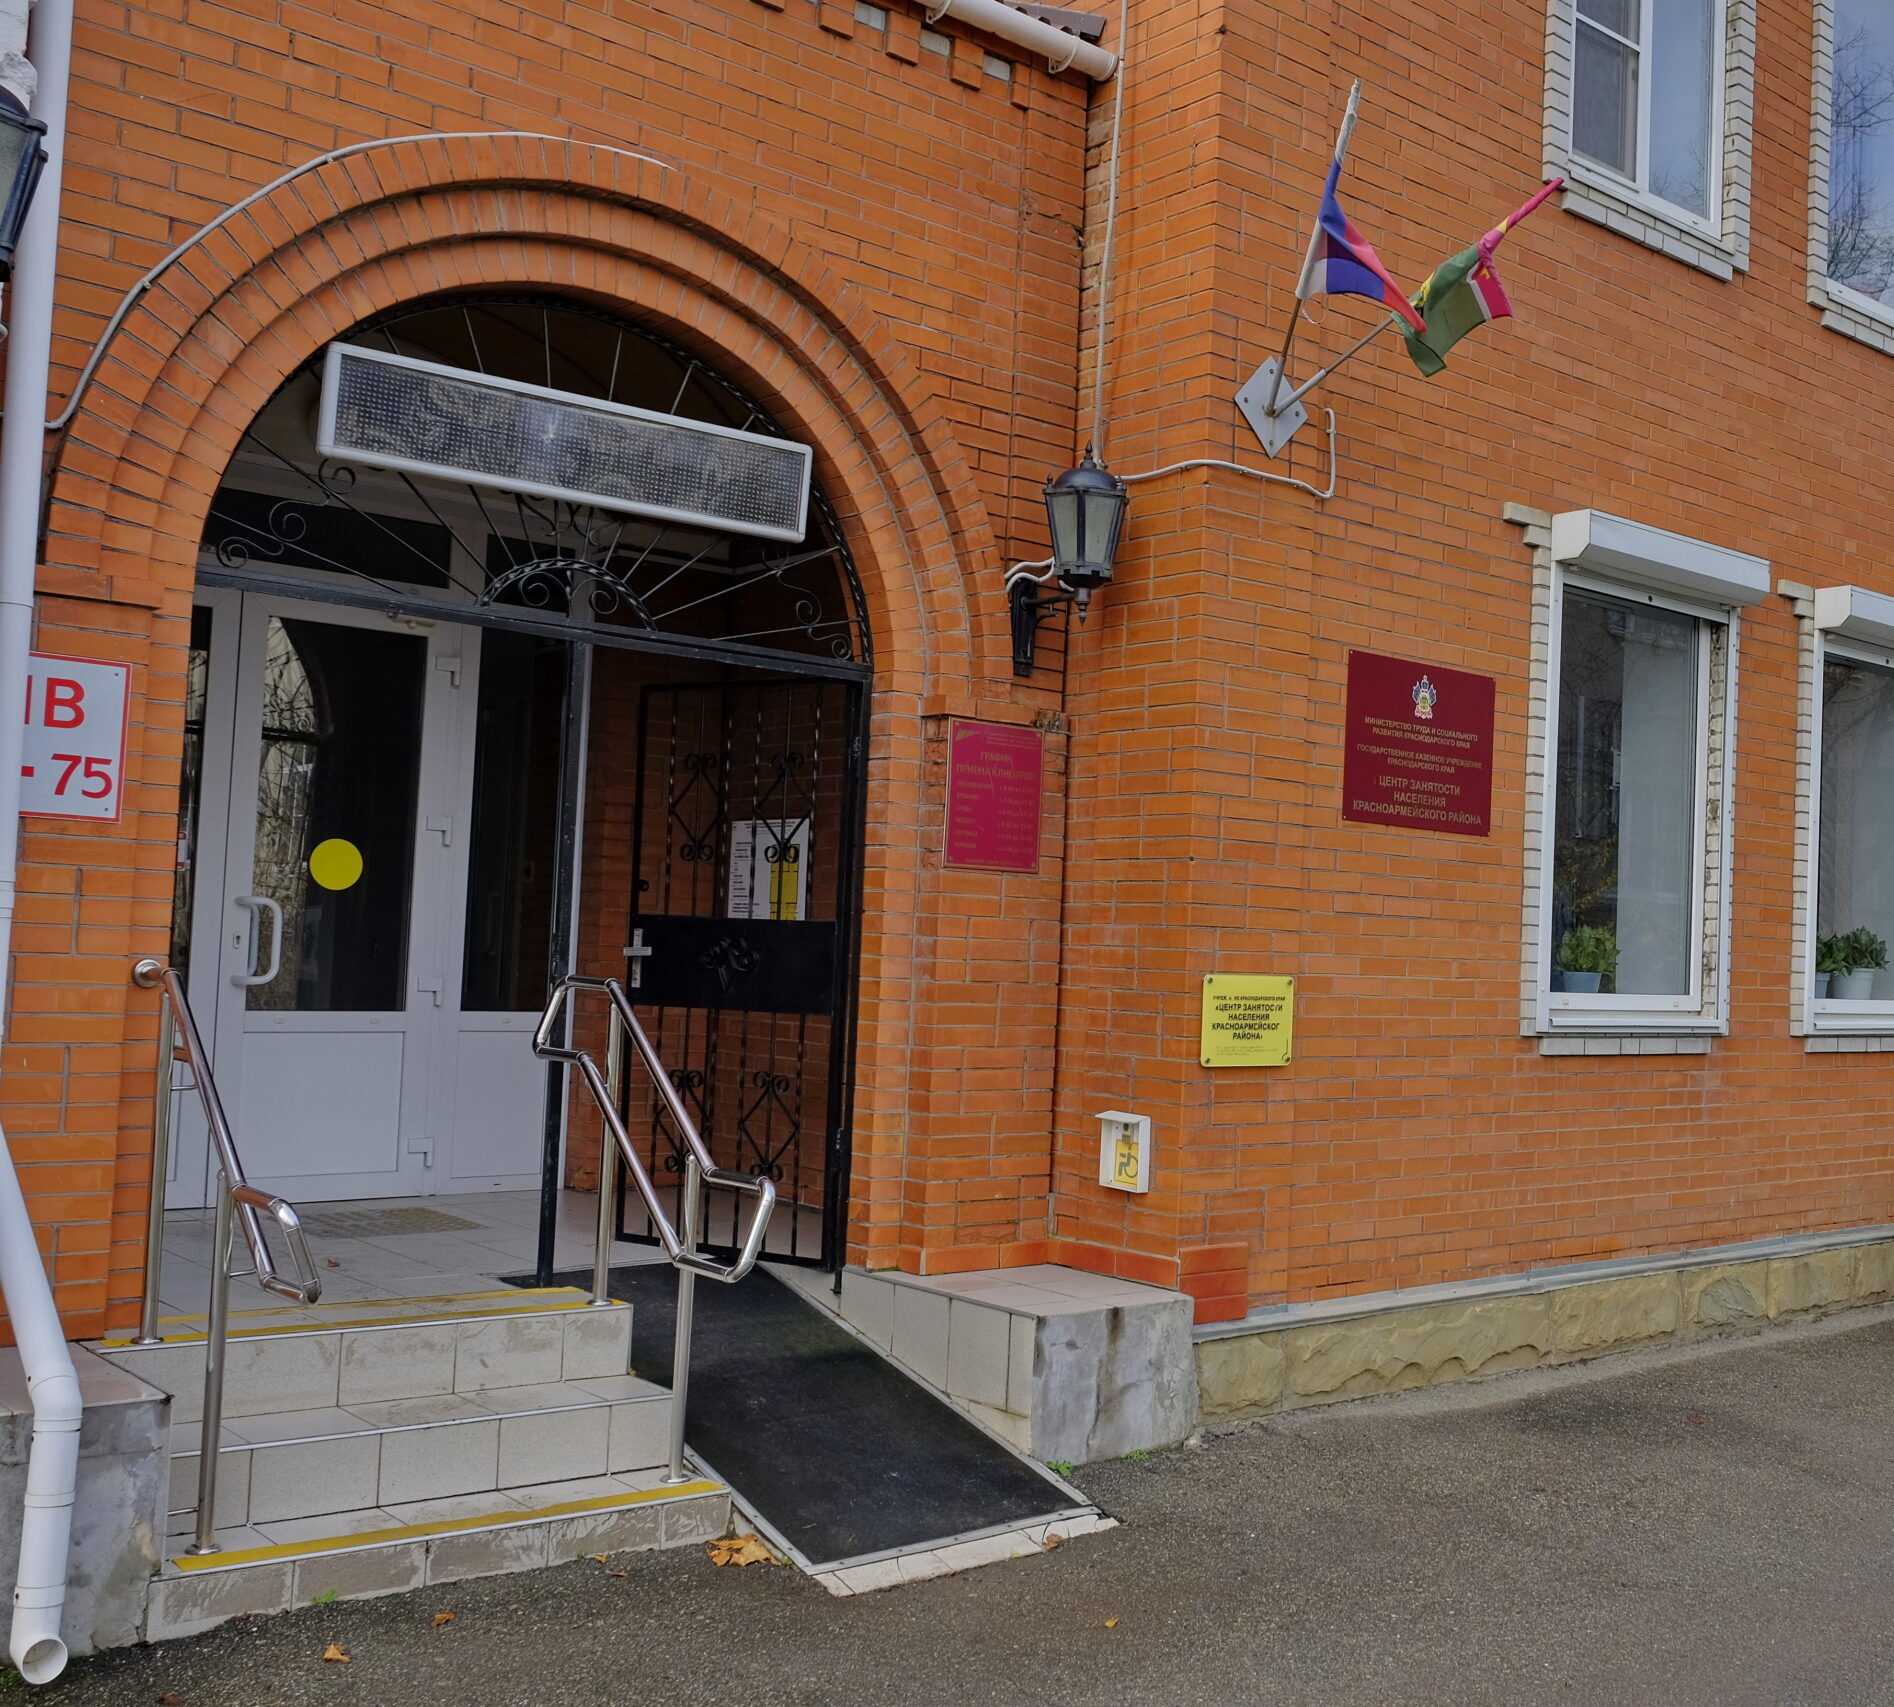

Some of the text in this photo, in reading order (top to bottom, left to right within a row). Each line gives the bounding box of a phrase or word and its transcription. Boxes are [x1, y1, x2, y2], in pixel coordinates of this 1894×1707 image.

[1364, 716, 1478, 742] МИНИСТЕРСТВО ТРУДА И СОЦИАЛЬНОГО
[1372, 727, 1403, 738] РАЗВИТИЯ
[1404, 731, 1456, 747] КРАСНОДАРСКОГО
[1357, 744, 1415, 759] ГОСУДАРСТВЕННОЕ
[1415, 751, 1446, 764] КАЗЕННОЕ
[1387, 758, 1455, 774] КРАСНОДАРСКОГО КРАЯ
[1379, 775, 1461, 796] ЦЕНТР ЗАНЯТОСТИ
[1393, 791, 1446, 808] НАСЕЛЕНИЯ
[1353, 799, 1482, 826] КРАСНОАРМЕЙСКОГО РАЙОНА
[1228, 1012, 1270, 1021] НАСЕЛЕНИЯ
